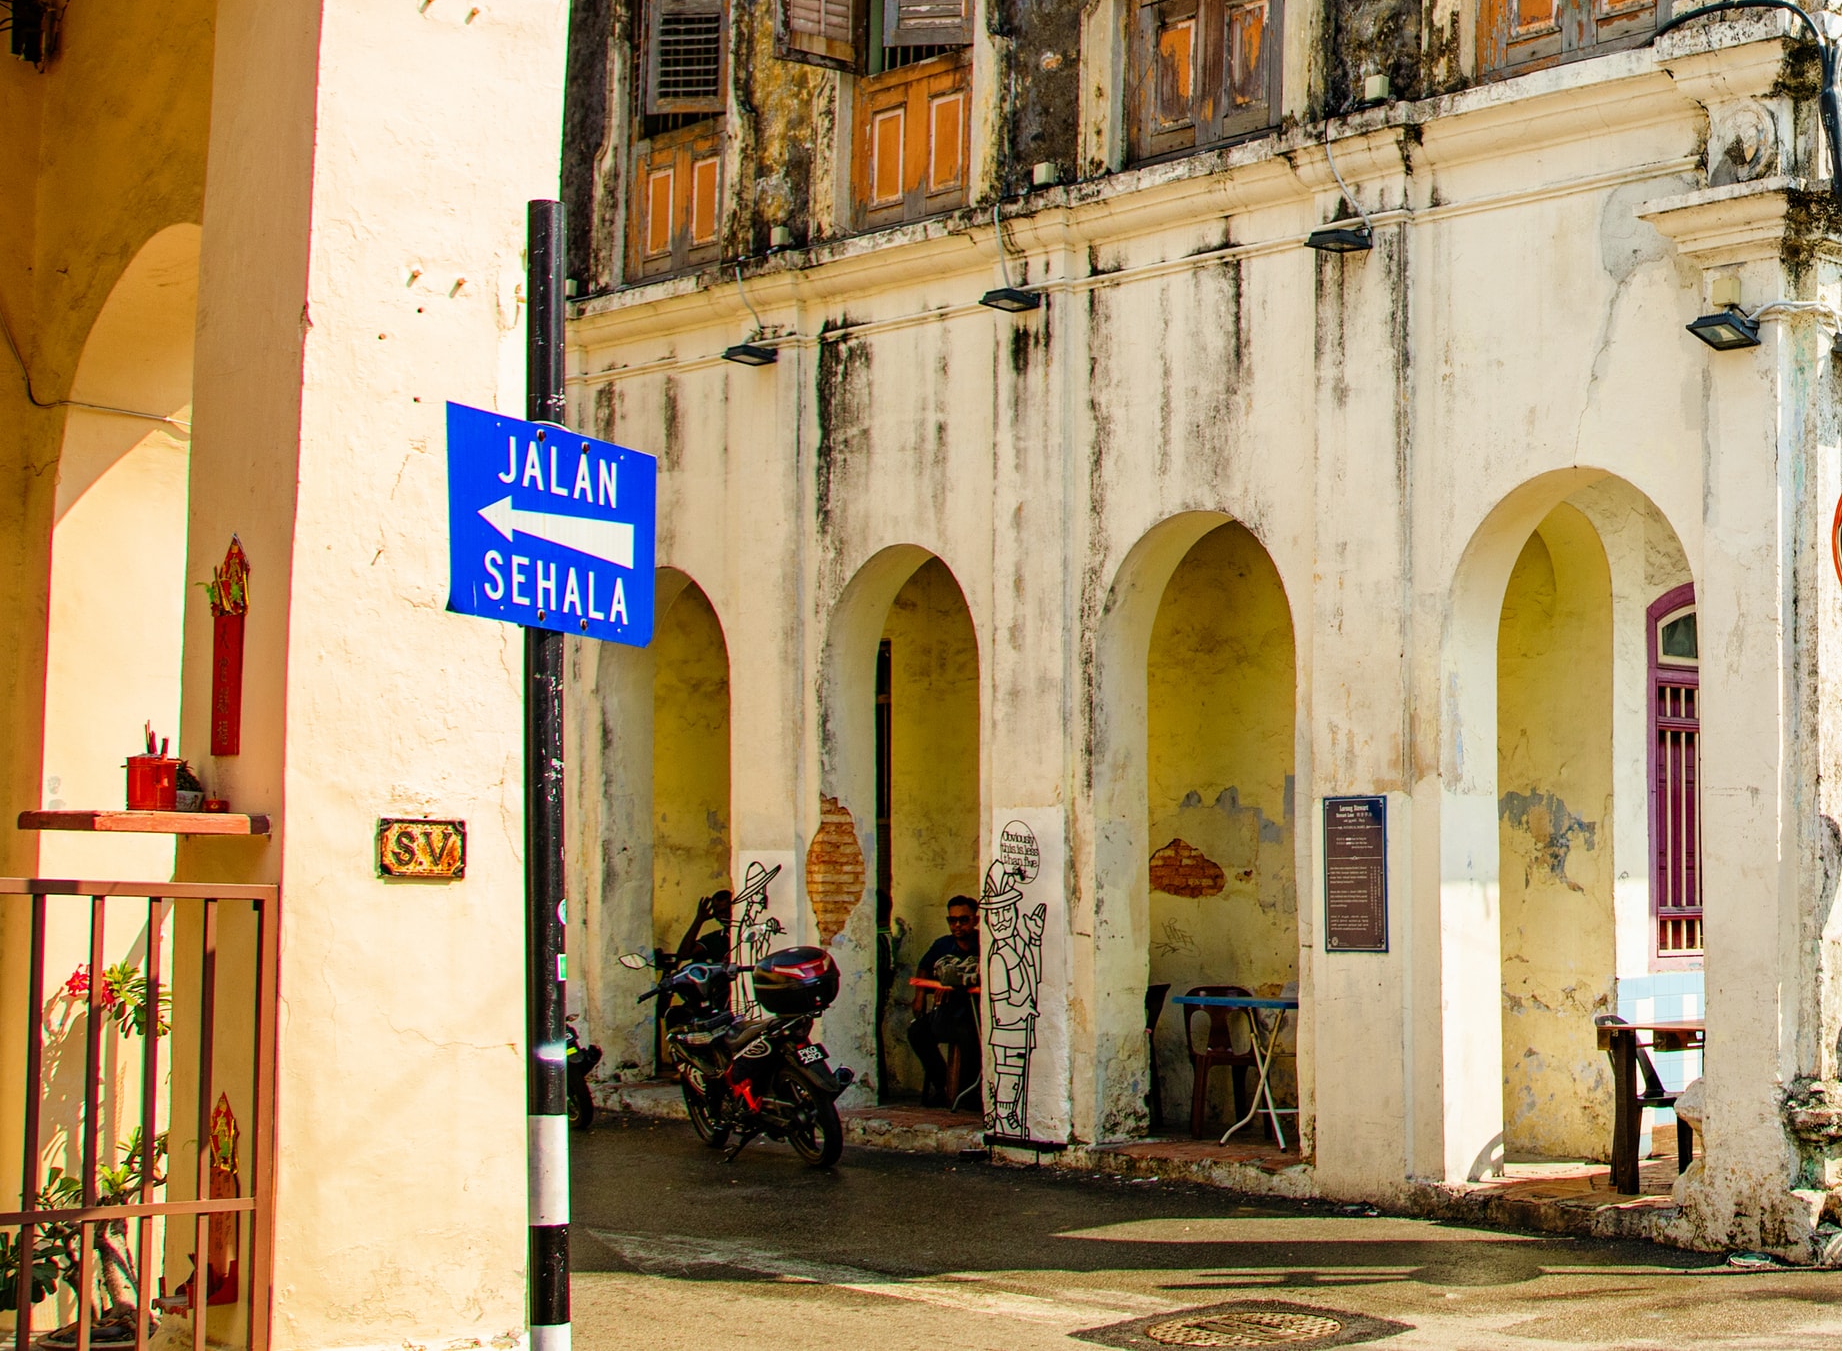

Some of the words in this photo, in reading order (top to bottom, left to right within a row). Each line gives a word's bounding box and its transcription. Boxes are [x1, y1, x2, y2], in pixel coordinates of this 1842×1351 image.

[498, 436, 617, 509] JALAN
[484, 550, 629, 625] SEHALA
[1002, 831, 1035, 847] Obviously
[1001, 843, 1016, 854] this
[1024, 845, 1039, 856] less
[1003, 854, 1023, 866] than
